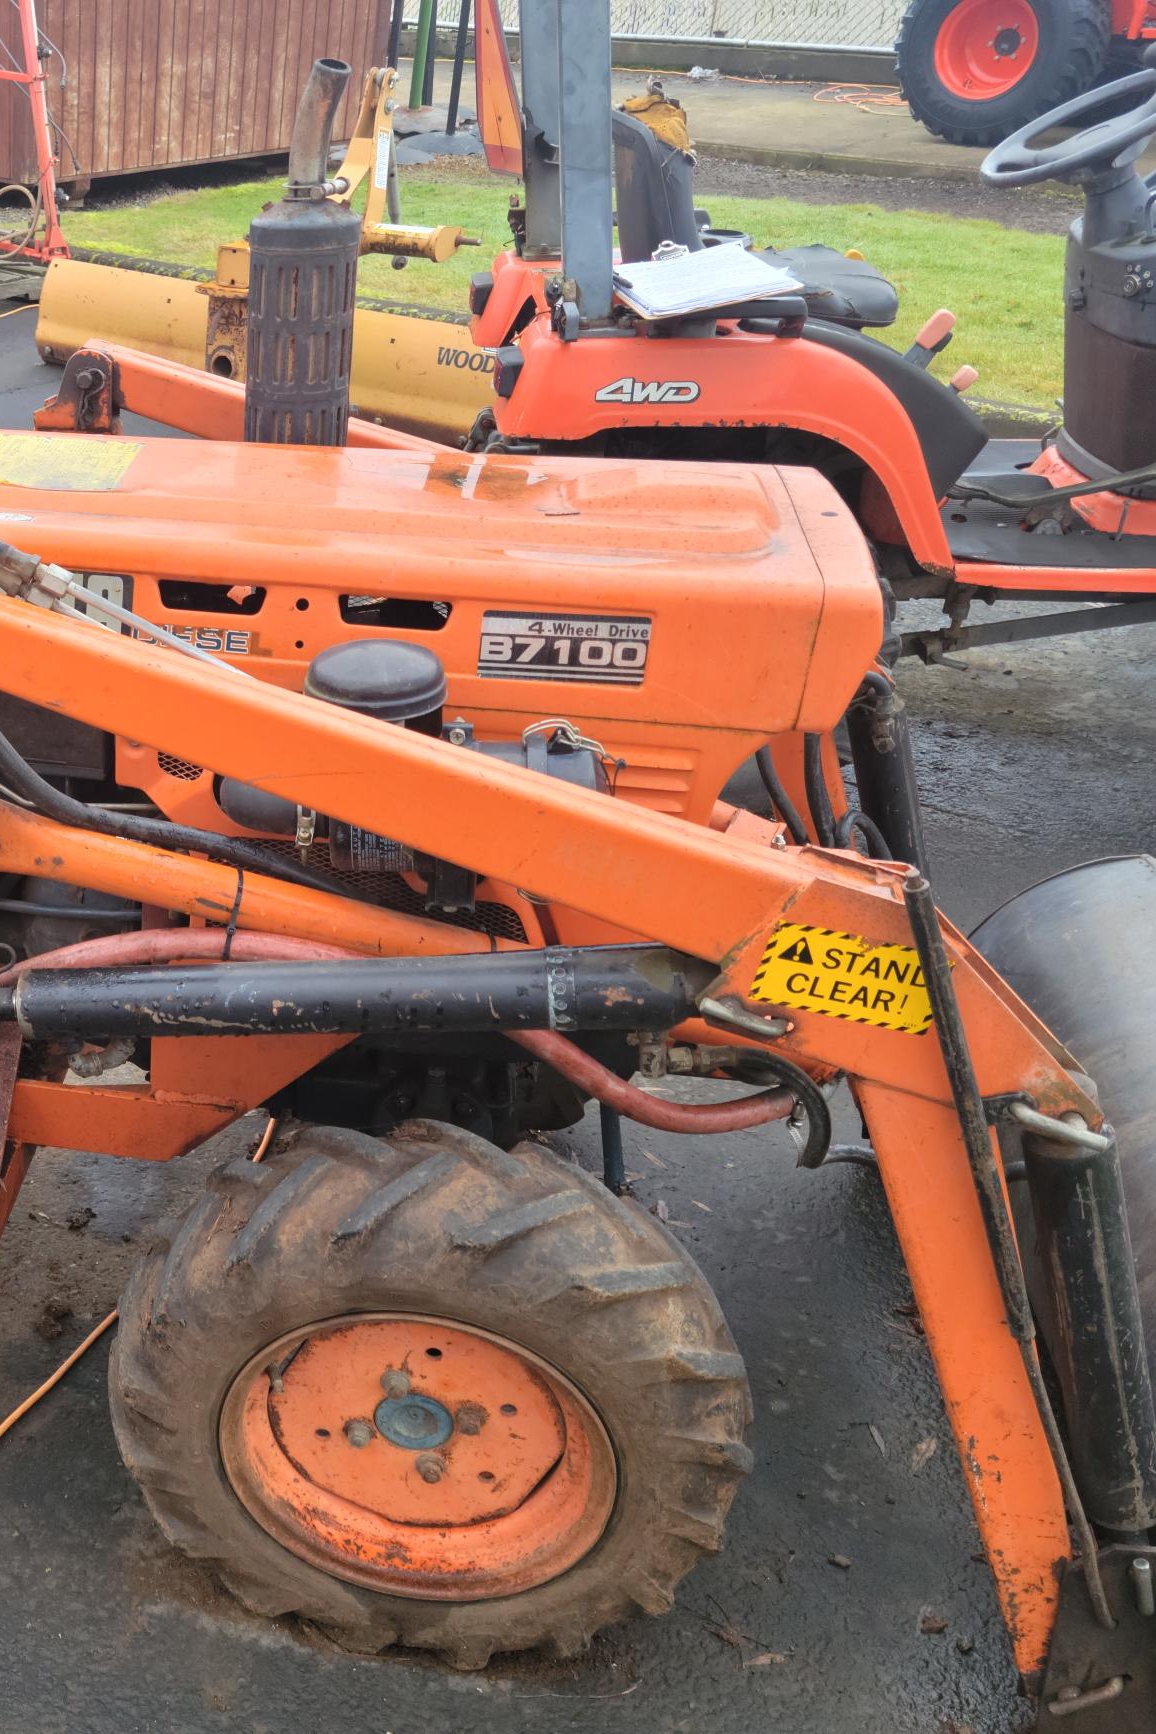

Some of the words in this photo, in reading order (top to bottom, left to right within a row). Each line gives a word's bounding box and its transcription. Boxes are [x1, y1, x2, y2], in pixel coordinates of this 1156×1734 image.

[595, 377, 700, 403] 4WD
[608, 624, 649, 639] Drive
[479, 635, 647, 667] B7100
[785, 972, 909, 1015] CLEAR!
